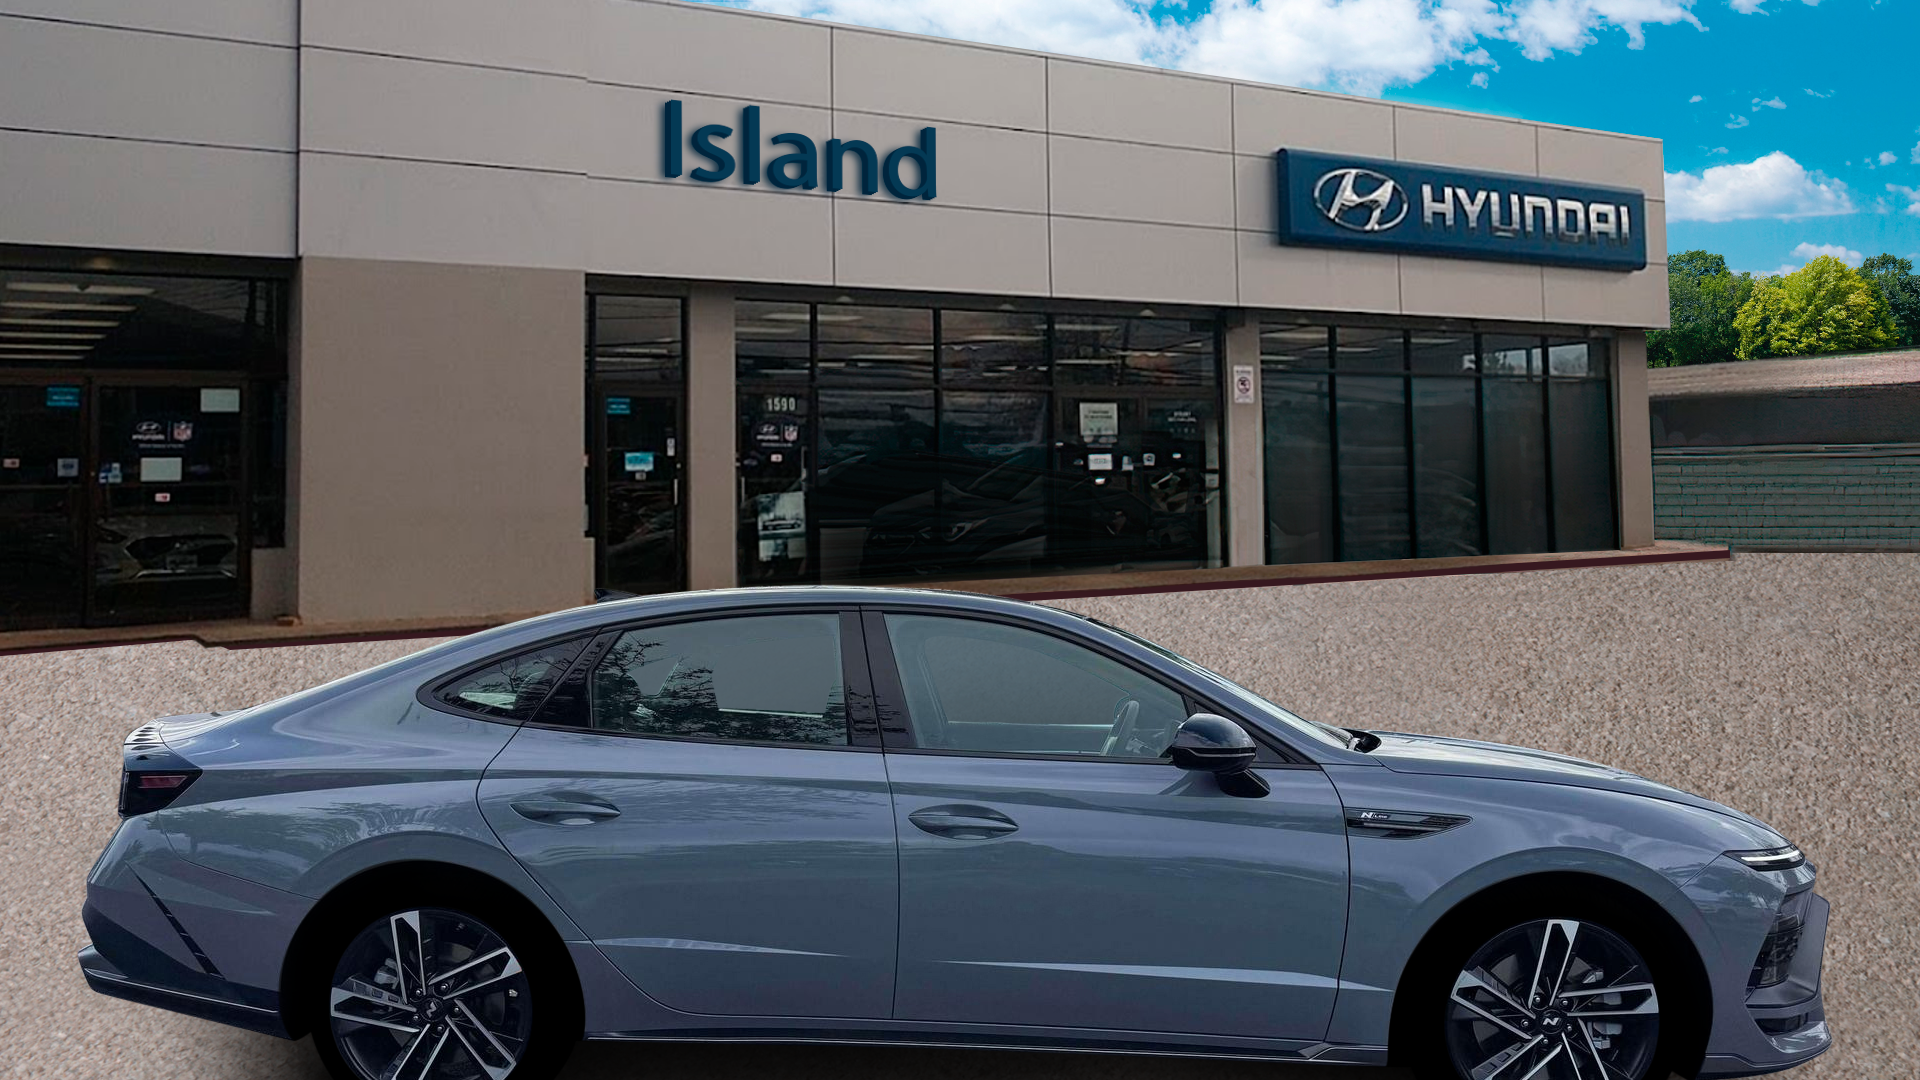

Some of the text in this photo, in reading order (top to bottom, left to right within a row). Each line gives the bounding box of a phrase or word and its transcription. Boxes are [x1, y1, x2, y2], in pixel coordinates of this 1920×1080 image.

[664, 99, 937, 201] Island
[1421, 184, 1630, 243] HYUNDAI
[767, 396, 796, 412] 1590
